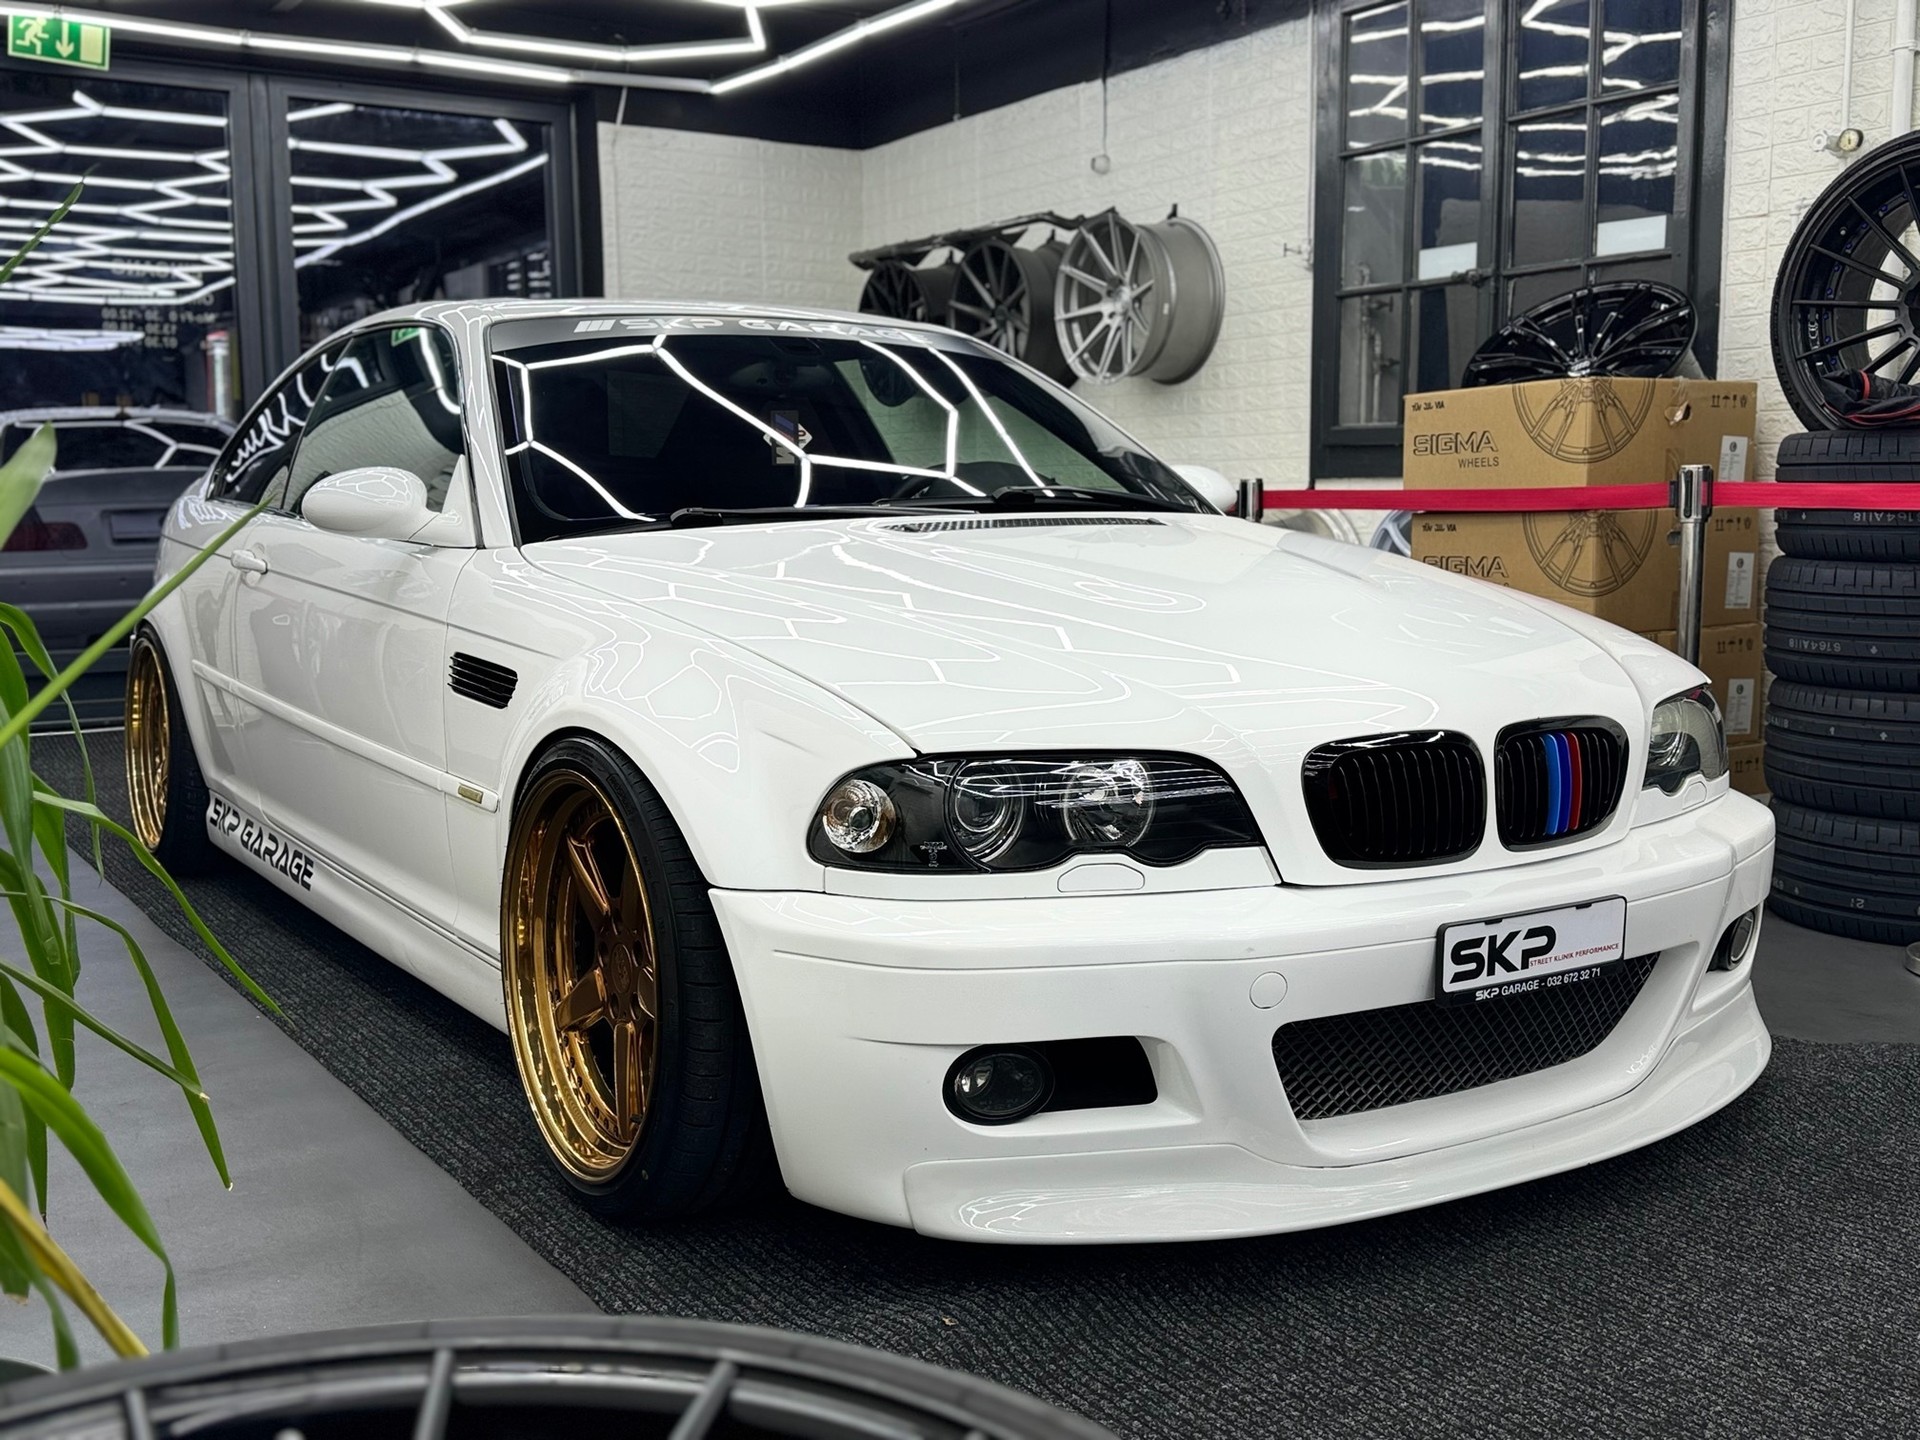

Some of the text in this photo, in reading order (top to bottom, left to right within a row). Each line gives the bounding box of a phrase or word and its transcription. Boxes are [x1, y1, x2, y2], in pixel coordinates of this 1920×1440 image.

[619, 317, 933, 345] SKP GARAGE
[1413, 430, 1499, 456] SIGMA
[1458, 456, 1500, 469] WHEELS
[210, 797, 314, 892] SKP GARAGE
[1449, 925, 1557, 985] SKP
[1530, 942, 1620, 967] STREET KLINIK PERFORMANCE
[1475, 987, 1500, 1001] SKP
[1501, 979, 1540, 996] GARAGE
[1546, 975, 1562, 987] 032
[1563, 972, 1578, 984] 672
[1579, 970, 1591, 981] 32
[1591, 967, 1601, 978] 71
